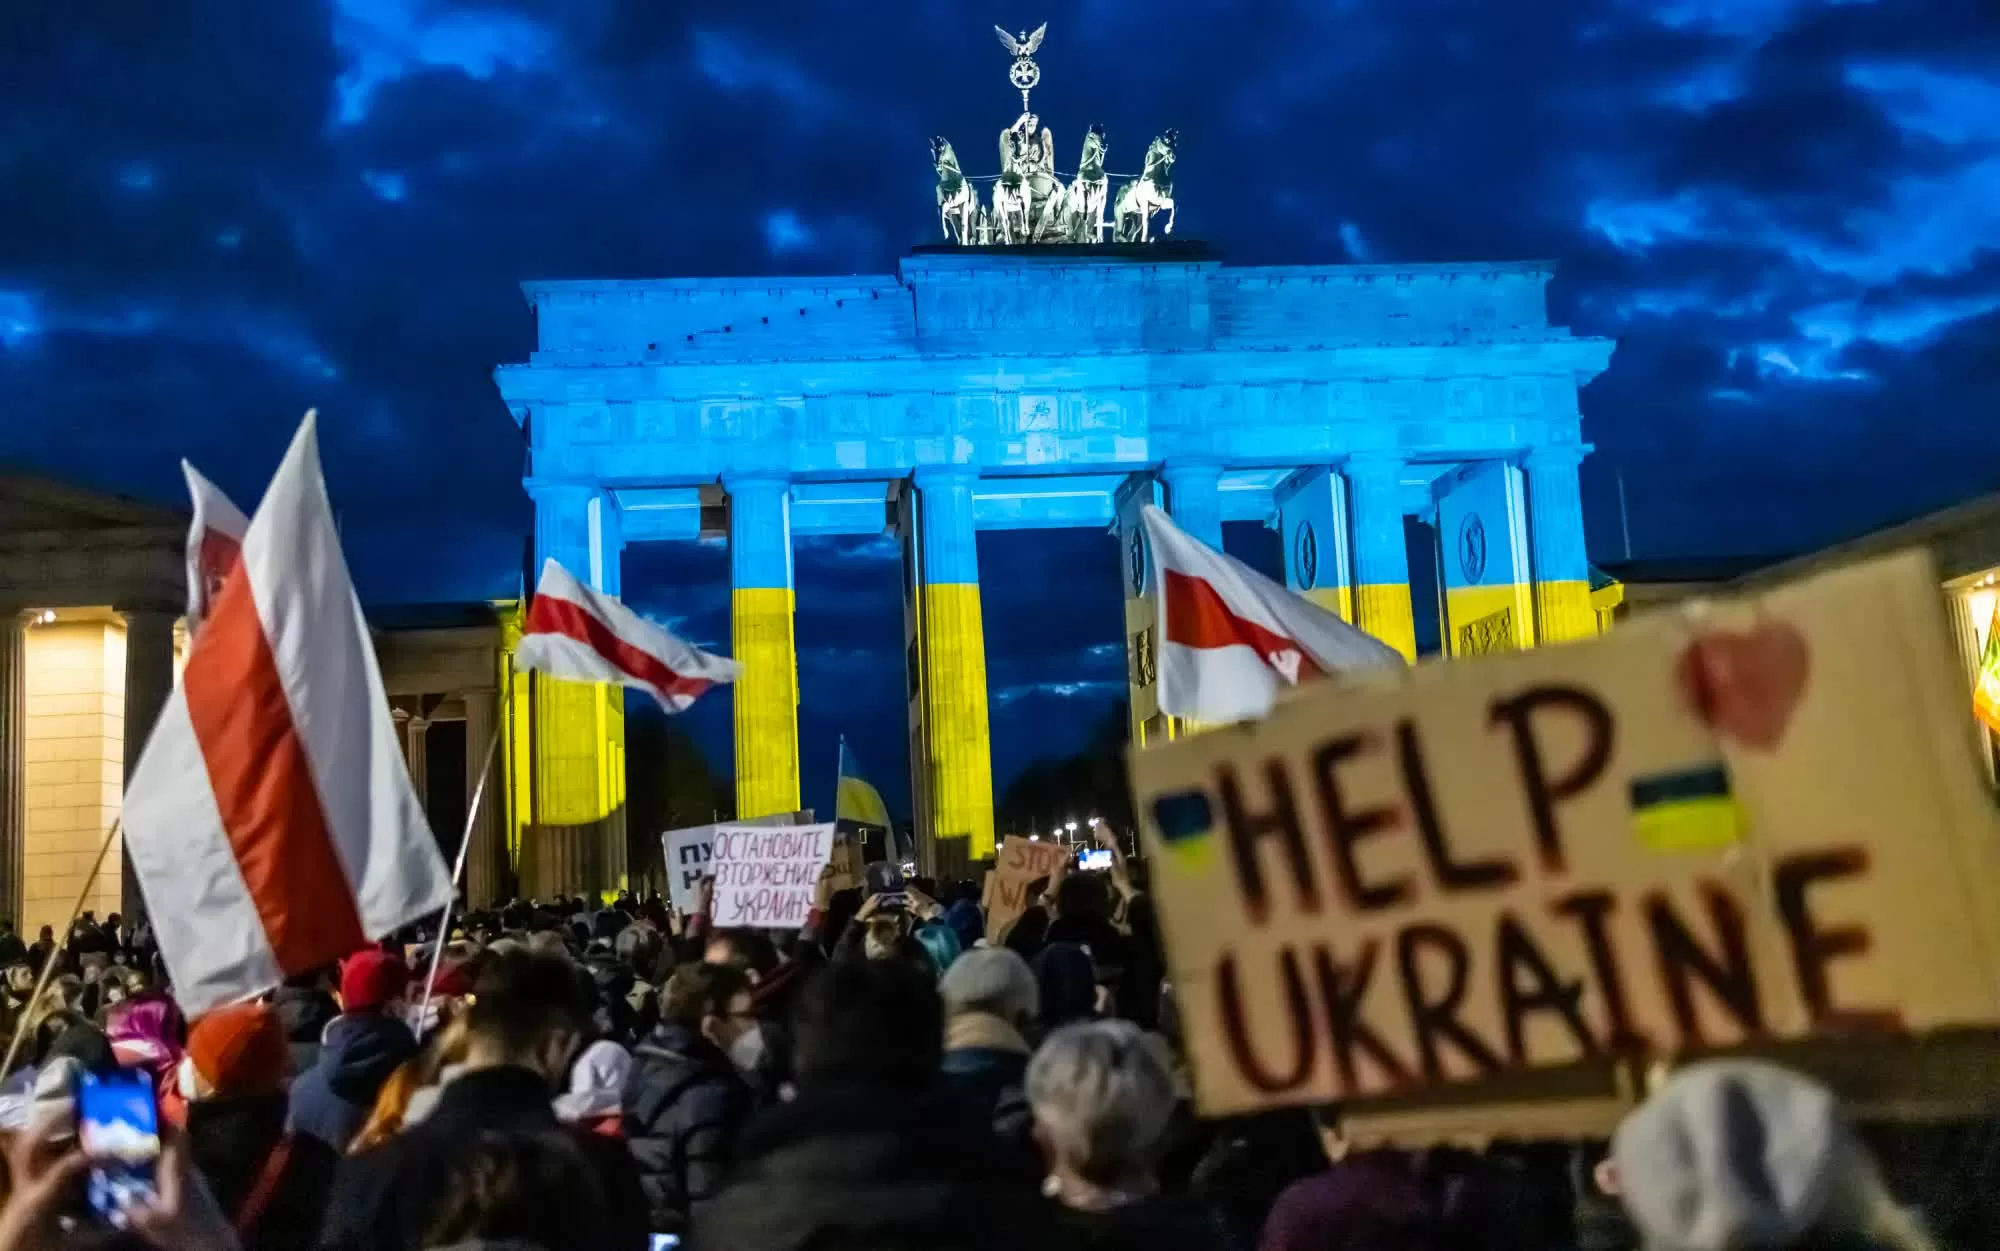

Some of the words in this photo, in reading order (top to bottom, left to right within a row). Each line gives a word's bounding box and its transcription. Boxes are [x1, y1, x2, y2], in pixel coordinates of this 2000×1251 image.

[714, 831, 824, 860] ОСТАНОВИТЕ
[1209, 686, 1614, 925] HELP
[715, 861, 821, 887] ВТОРЖЕНИЕ
[1213, 843, 1904, 1094] UKRAINE
